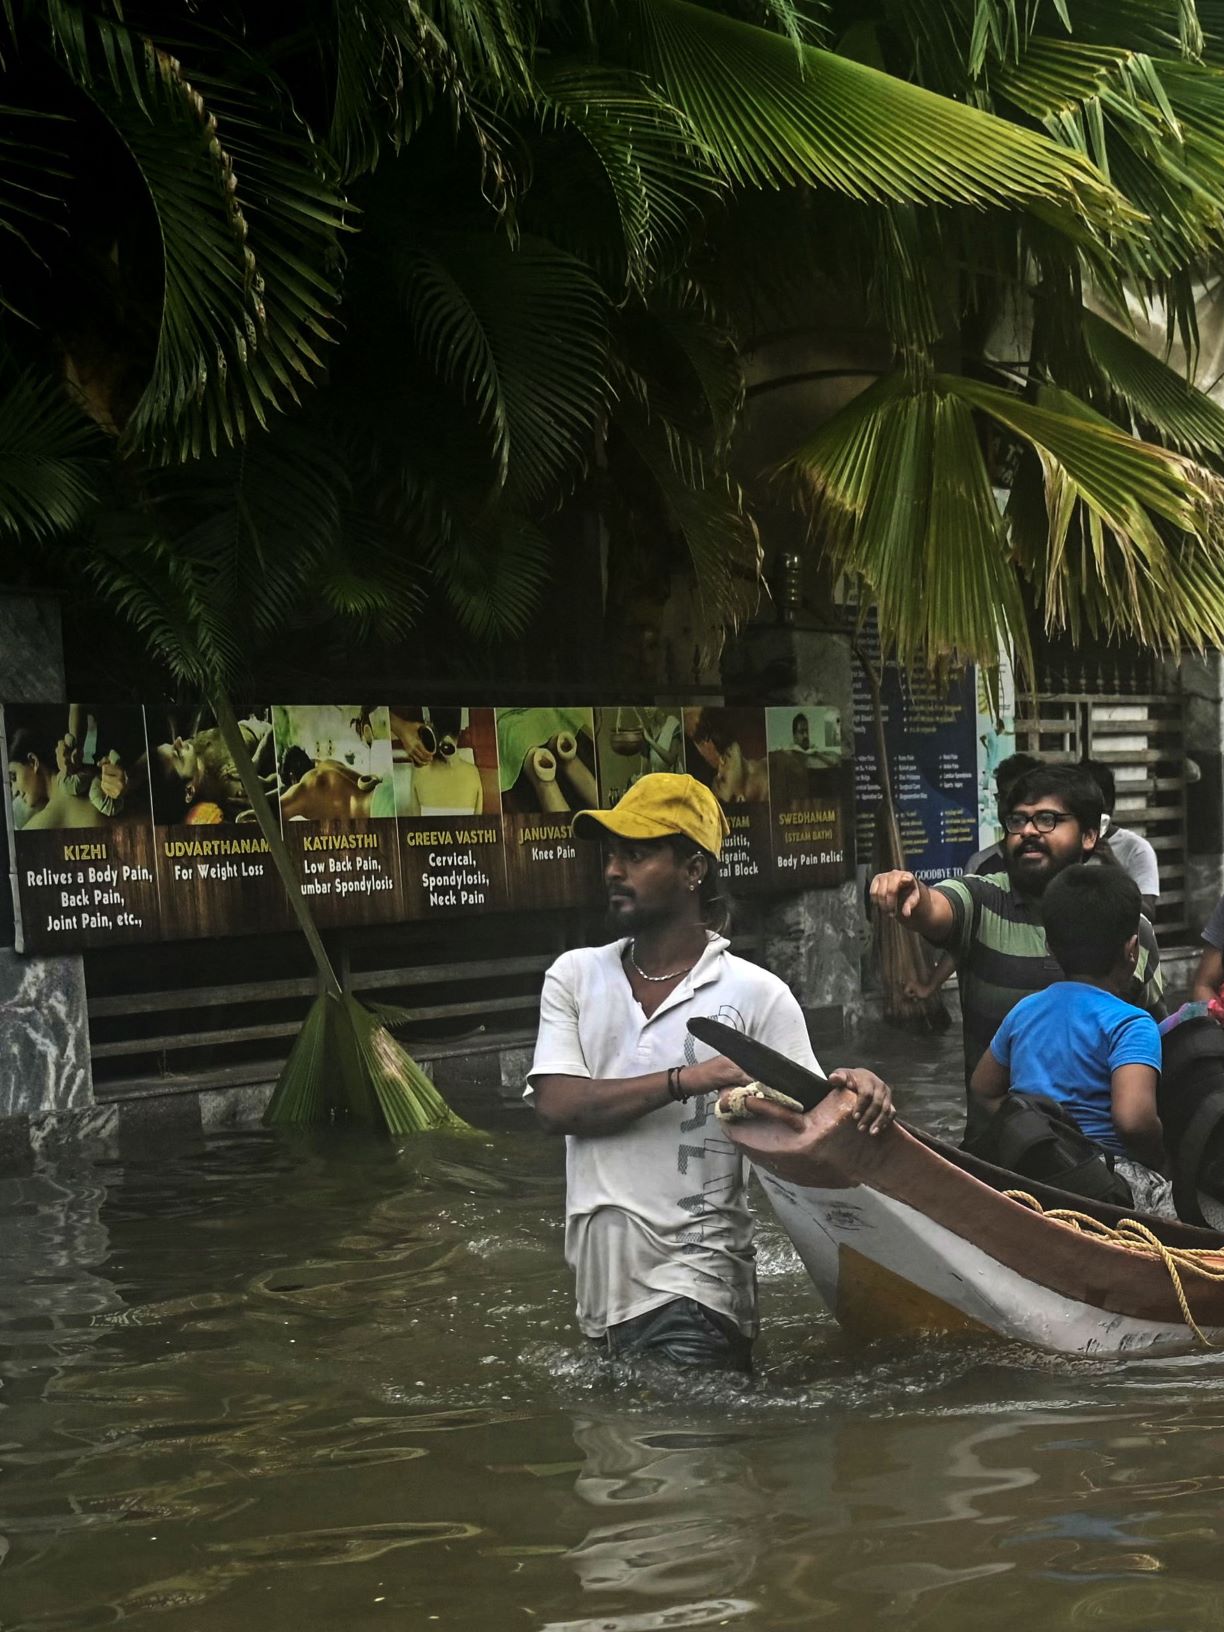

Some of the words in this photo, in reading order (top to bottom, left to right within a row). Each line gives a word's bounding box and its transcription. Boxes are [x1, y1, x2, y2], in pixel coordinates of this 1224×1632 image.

[778, 810, 836, 825] SWEDHANAM
[303, 833, 378, 852] KATIVASTHI
[407, 830, 453, 847] GREEVA
[455, 829, 497, 846] VASTHI
[518, 825, 572, 845] JANUVAST
[64, 843, 107, 861] KIZHI
[428, 849, 477, 868] Cervical,
[532, 847, 554, 861] Knee
[556, 845, 576, 859] Pain
[777, 854, 798, 870] Body
[800, 853, 818, 866] Pain
[820, 850, 844, 864] Relief
[175, 865, 193, 881] For
[197, 861, 239, 881] Weight
[241, 861, 264, 877] Loss
[304, 859, 325, 874] Low
[329, 856, 353, 873] Back
[356, 855, 381, 872] Pain,
[735, 861, 759, 876] Block
[27, 868, 73, 887] Relives
[77, 872, 84, 884] a
[88, 867, 118, 887] Body
[123, 864, 153, 883] Pain,
[422, 871, 490, 891] Spondylosis,
[301, 878, 331, 896] umbar
[335, 876, 394, 897] Spondylosis
[61, 889, 90, 907] Back
[94, 889, 125, 907] Pain,
[429, 892, 457, 907] Neck
[461, 890, 485, 905] Pain
[47, 914, 77, 932] Joint
[82, 913, 113, 930] Pain,
